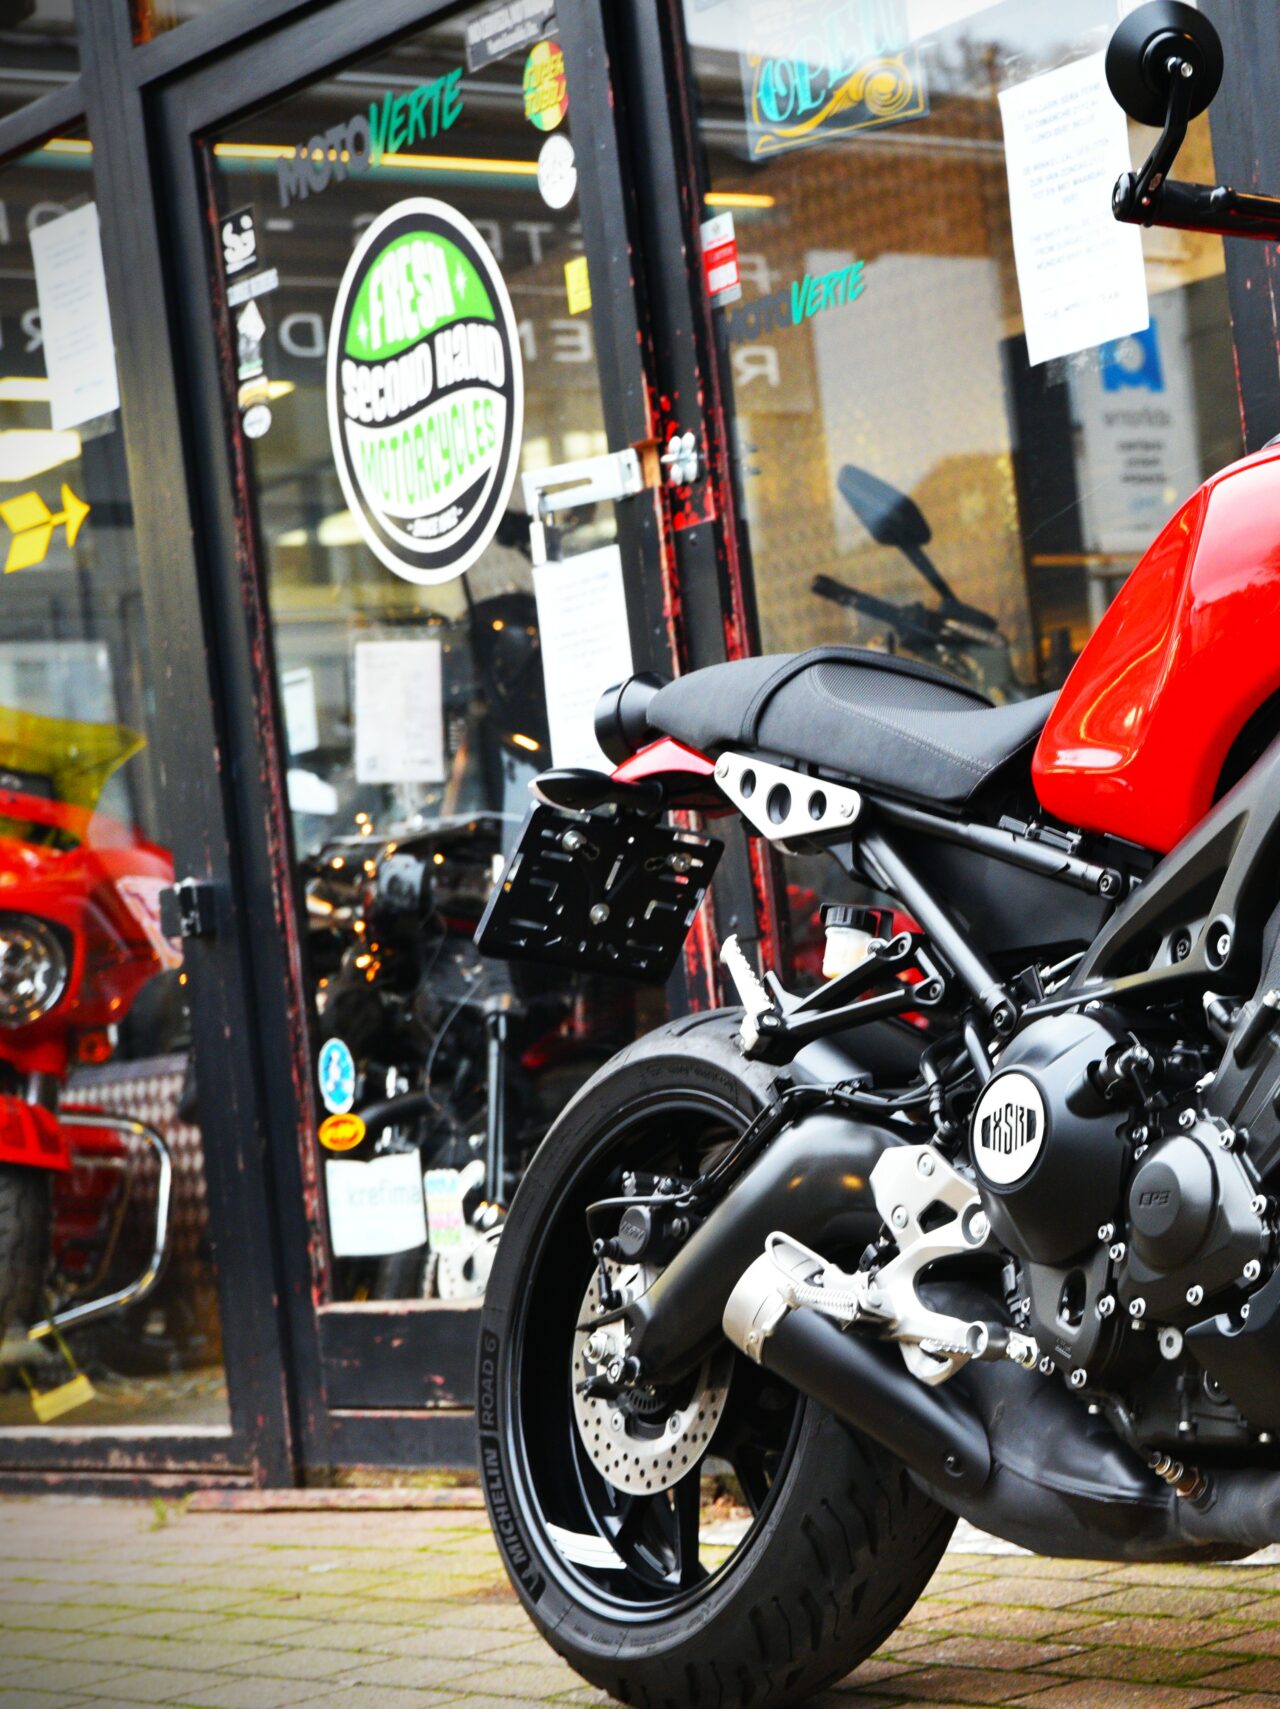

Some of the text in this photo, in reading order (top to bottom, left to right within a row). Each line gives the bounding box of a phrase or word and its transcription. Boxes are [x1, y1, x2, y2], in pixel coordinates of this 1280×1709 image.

[369, 240, 456, 352] FRESH
[481, 1334, 528, 1563] MICHELIN ROAD 6
